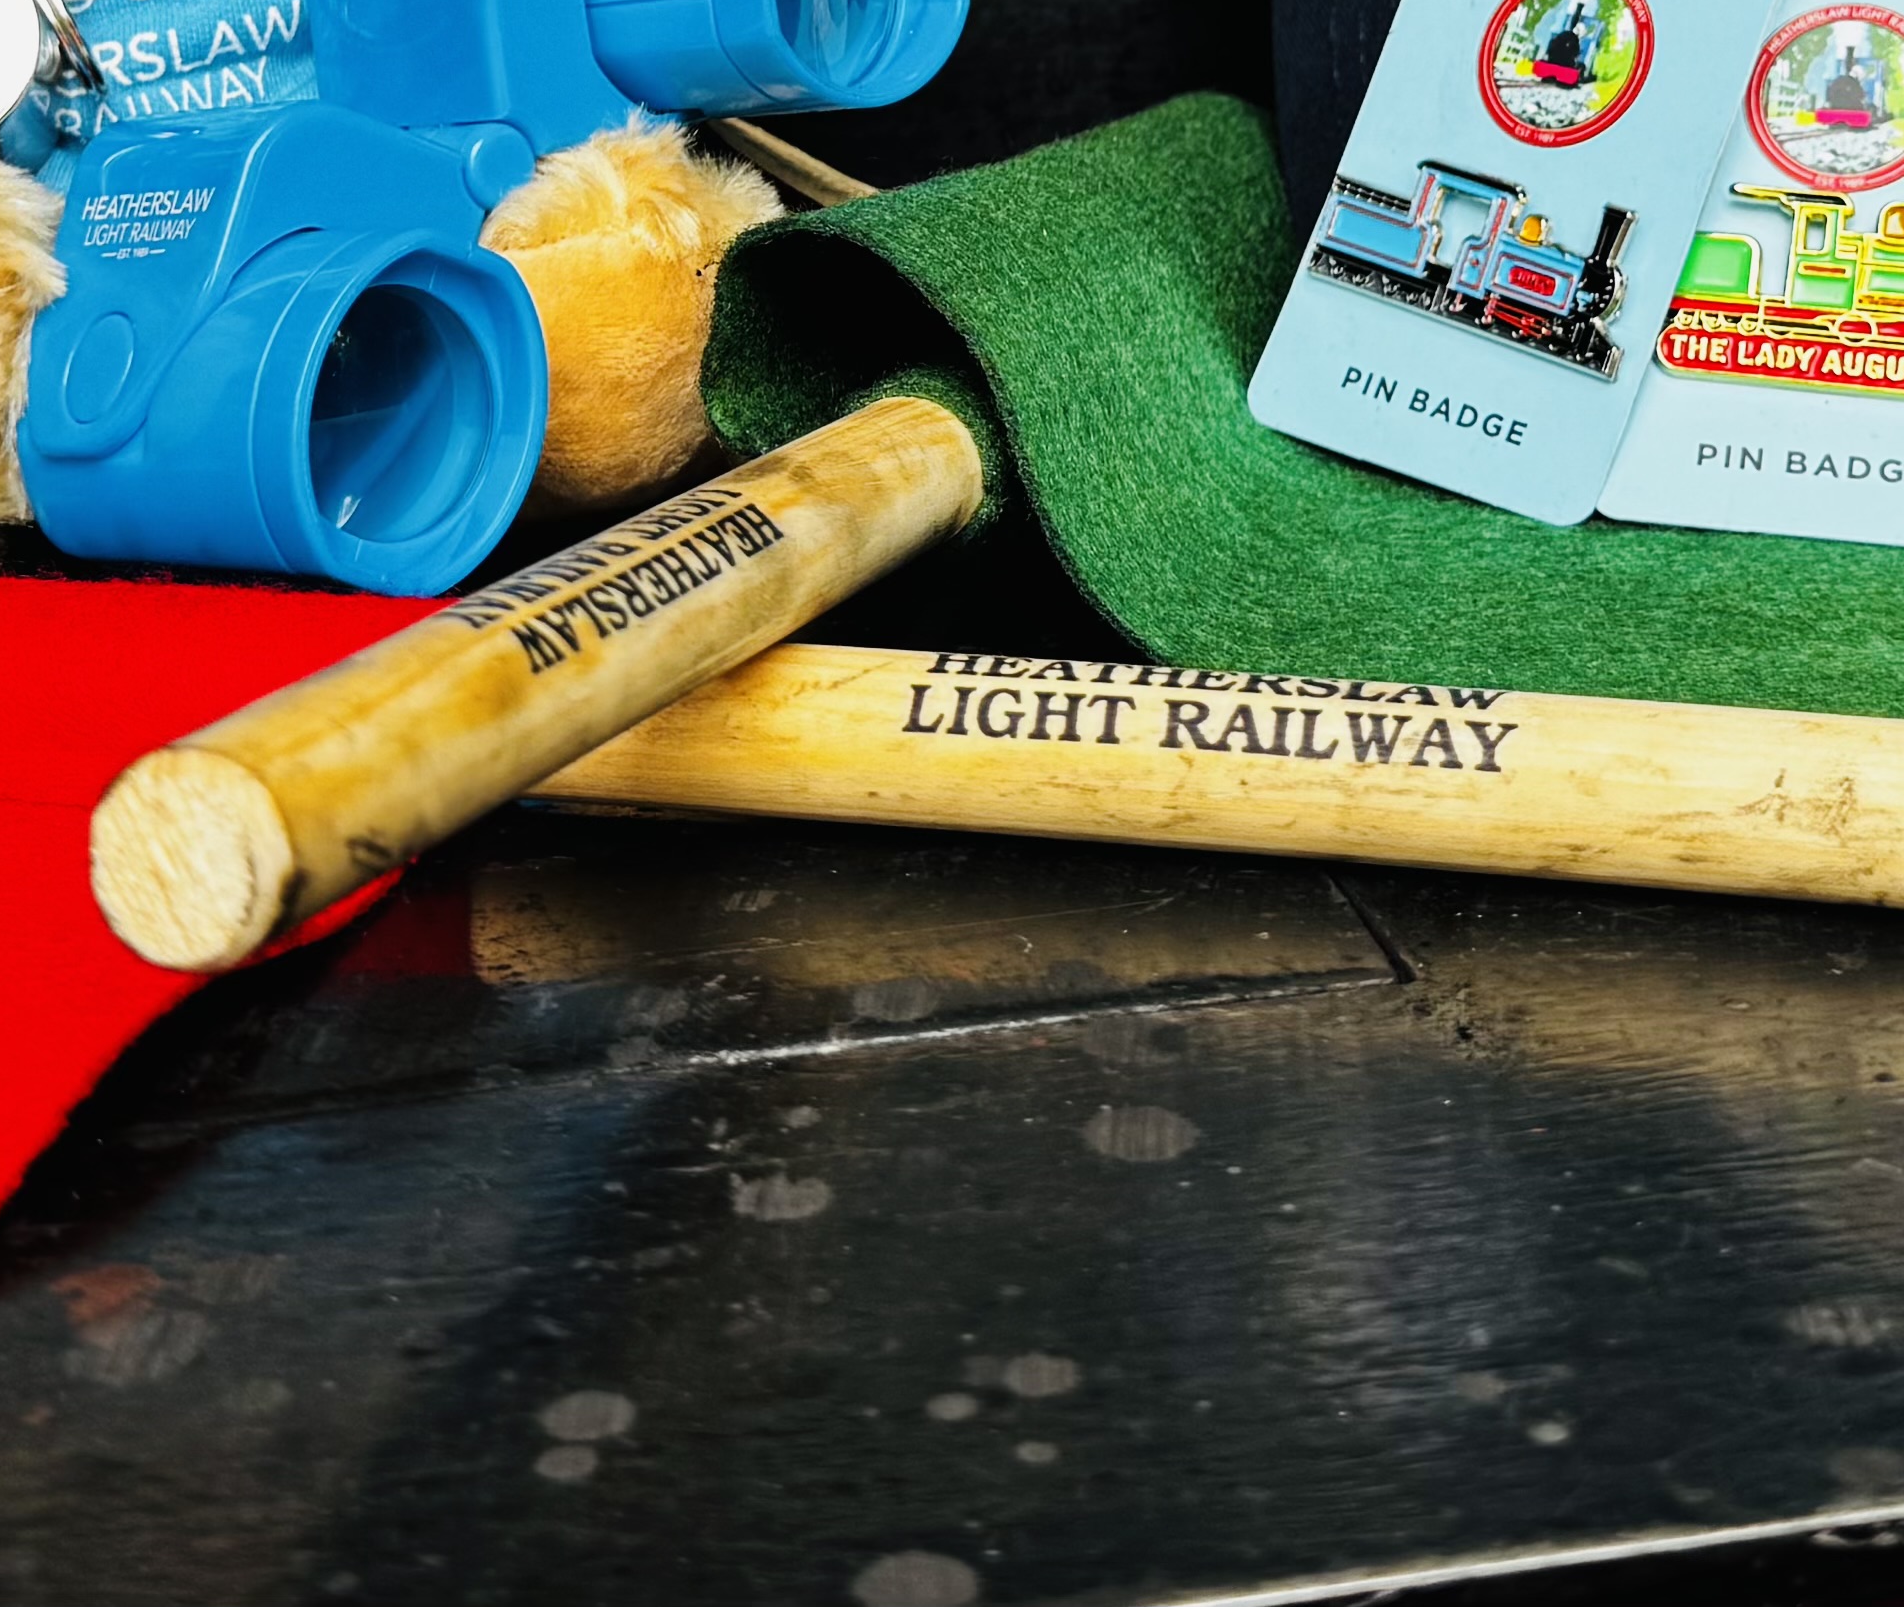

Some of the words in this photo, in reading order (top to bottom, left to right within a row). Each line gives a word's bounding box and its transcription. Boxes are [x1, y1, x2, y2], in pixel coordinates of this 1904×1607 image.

[1767, 7, 1850, 54] HEATHERSLAW
[1852, 7, 1890, 23] LIGHT
[81, 187, 216, 222] HEATHERSLAW
[83, 222, 131, 247] LIGHT
[128, 217, 197, 244] RAILWAY
[1670, 333, 1729, 366] THE
[1736, 339, 1818, 373] LADY
[1340, 365, 1399, 405] PIN
[1407, 388, 1530, 448] BADGE
[1696, 442, 1765, 473] PIN
[508, 502, 786, 675] HEATHERSLAW
[925, 650, 1509, 712] HEATHERSLAW
[901, 683, 1137, 746] LIGHT
[1158, 697, 1519, 774] RAILWAY
